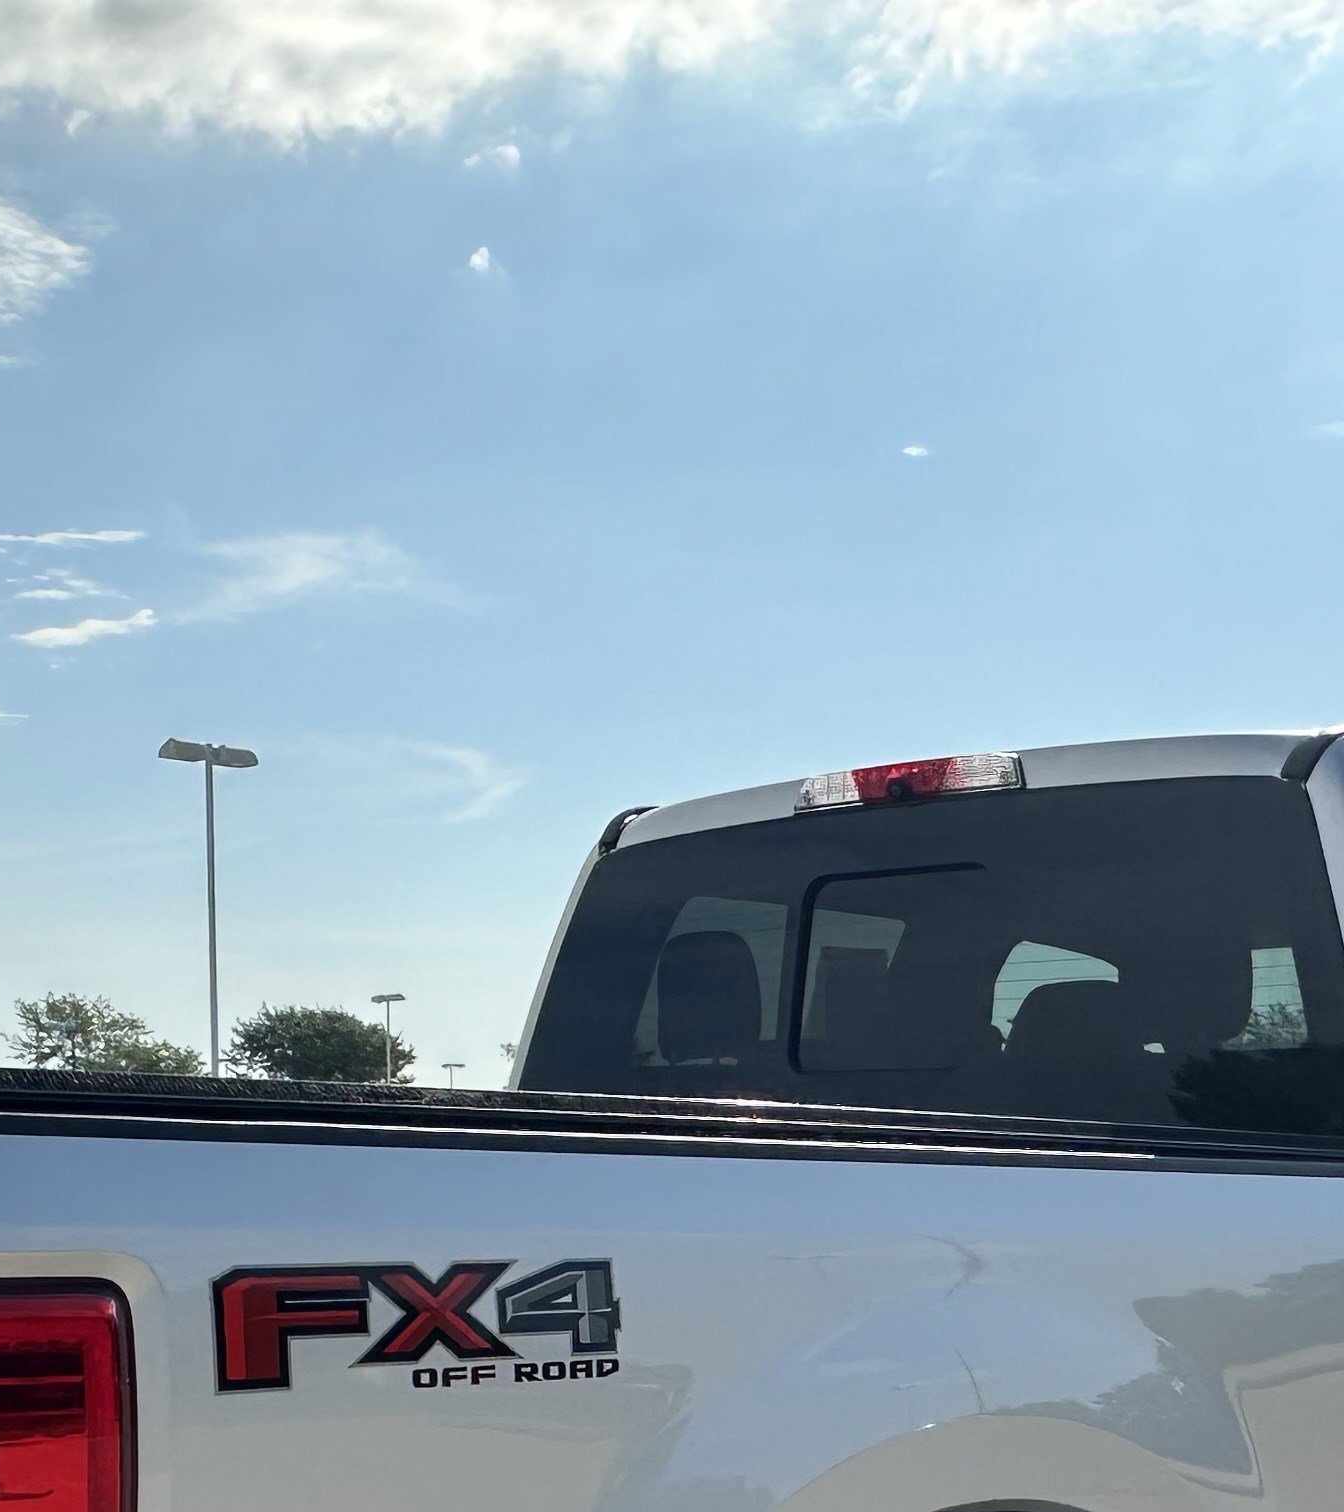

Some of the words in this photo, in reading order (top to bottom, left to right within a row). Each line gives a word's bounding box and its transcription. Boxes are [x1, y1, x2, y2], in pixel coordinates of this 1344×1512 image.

[209, 1257, 620, 1395] FX4
[411, 1363, 497, 1389] OFF
[513, 1357, 620, 1383] ROAD
